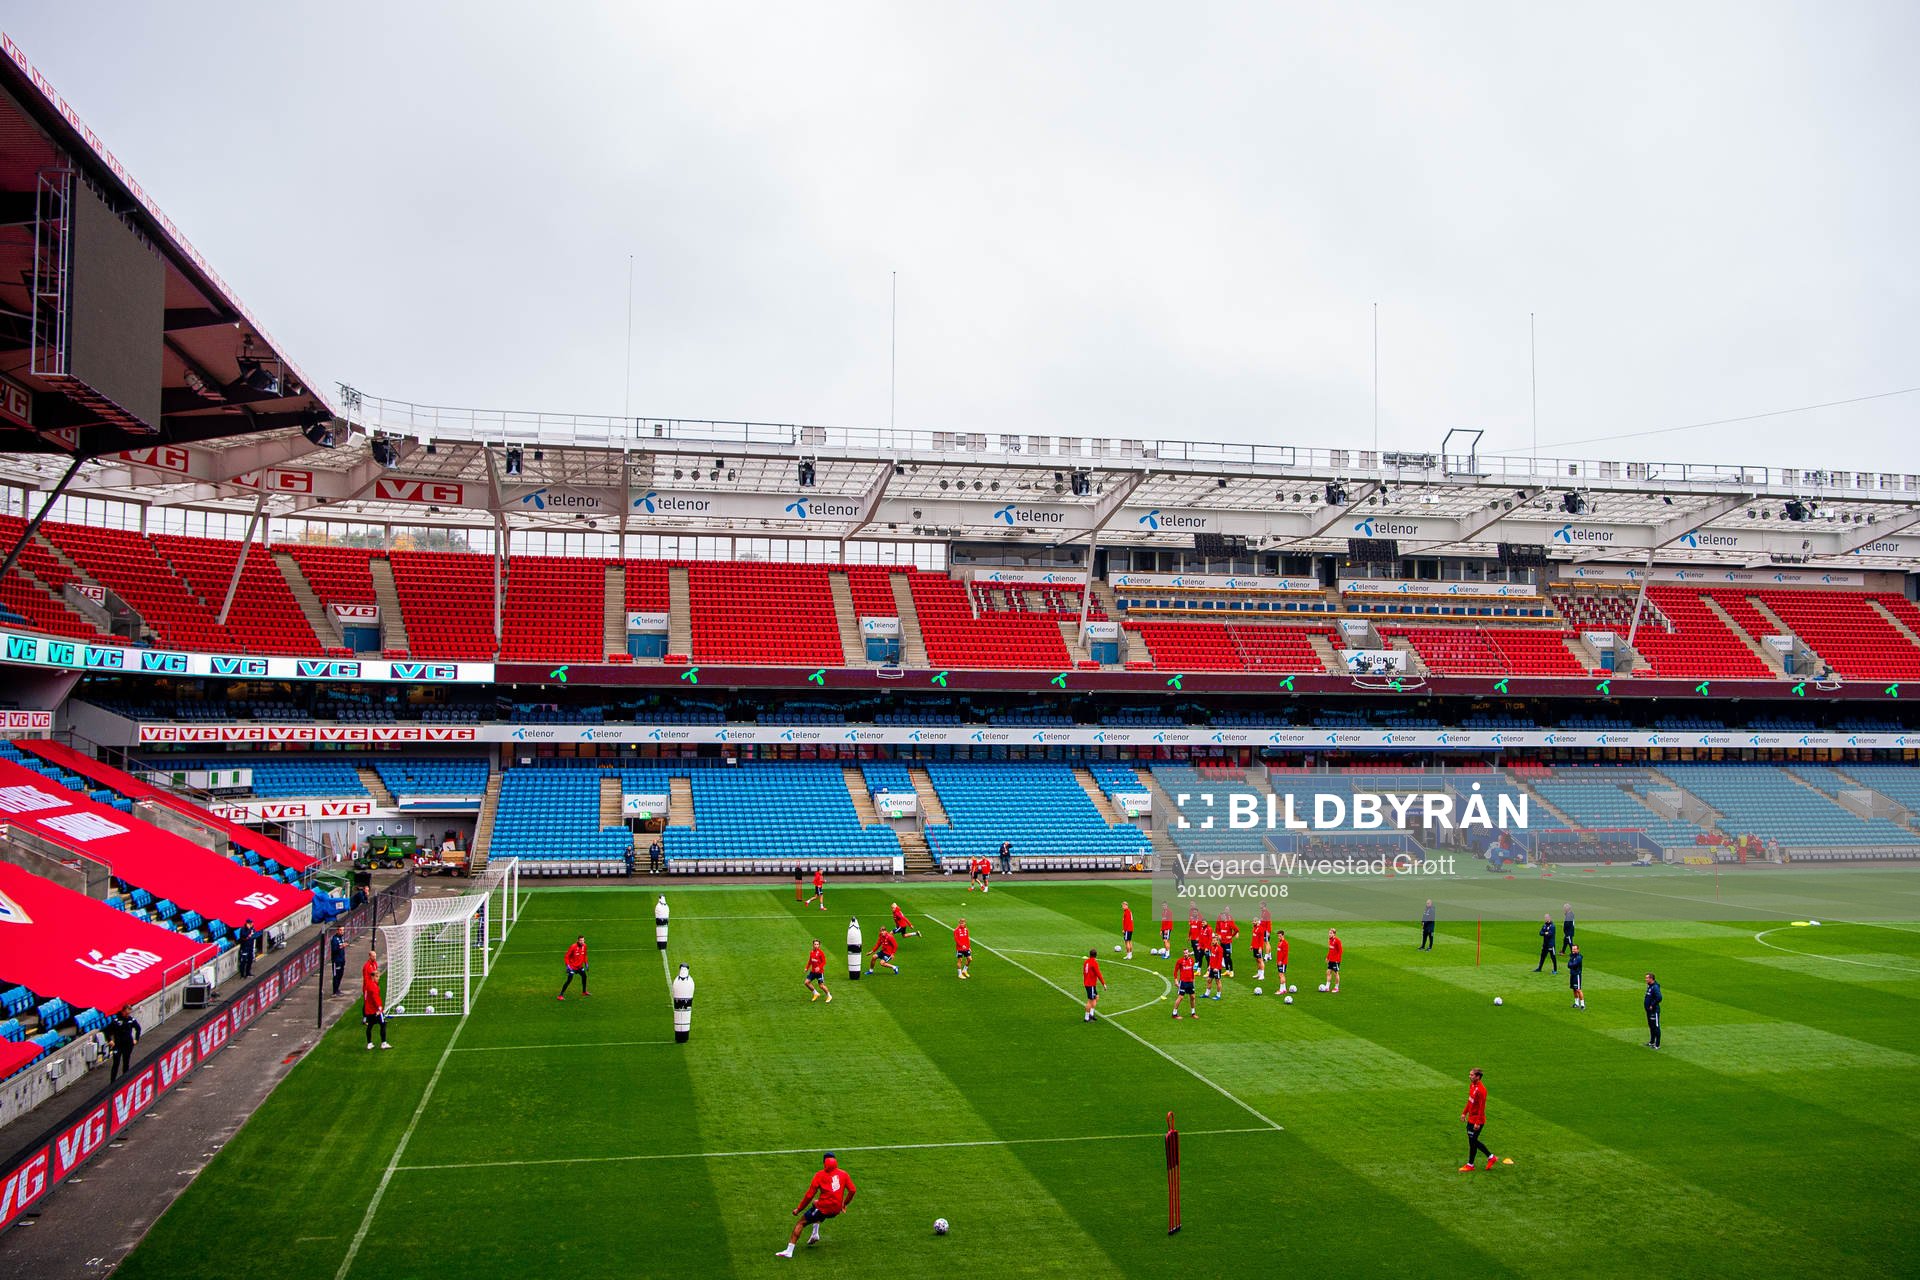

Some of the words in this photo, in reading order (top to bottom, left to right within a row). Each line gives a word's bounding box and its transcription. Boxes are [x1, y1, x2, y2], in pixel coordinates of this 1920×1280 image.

[127, 447, 188, 471] VG
[378, 479, 461, 503] VG
[547, 494, 601, 507] telenor
[658, 497, 710, 511] telenor
[809, 502, 859, 516] telenor
[1015, 509, 1064, 523] telenor
[1160, 514, 1207, 528] telenor
[1374, 522, 1418, 535] telenor
[1572, 529, 1614, 541] telenor
[1698, 534, 1738, 547] telenor
[998, 573, 1024, 581] telenor
[1126, 577, 1151, 585] telenor
[1180, 578, 1206, 586] telenor
[1234, 579, 1258, 587] telenor
[335, 606, 375, 617] VG
[641, 617, 664, 625] telenor
[874, 622, 896, 630] telenor
[8, 638, 36, 660] VG
[49, 644, 74, 663] VG
[85, 648, 123, 667] VG
[142, 653, 187, 672] VG
[1363, 654, 1398, 666] telenor
[211, 657, 267, 675] VG
[298, 661, 360, 678] VG
[391, 664, 456, 679] VG
[11, 714, 28, 726] VG
[32, 714, 49, 726] VG
[142, 728, 175, 740] VG
[180, 728, 218, 740] VG
[223, 728, 263, 740] VG
[269, 728, 315, 740] VG
[321, 728, 367, 740] VG
[374, 728, 419, 740] VG
[427, 728, 474, 740] VG
[525, 728, 554, 738] telenor
[593, 728, 622, 738] telenor
[661, 729, 689, 739] telenor
[727, 729, 755, 739] telenor
[792, 729, 820, 739] telenor
[857, 730, 884, 740] telenor
[920, 730, 947, 740] telenor
[983, 730, 1009, 740] telenor
[1044, 731, 1070, 741] telenor
[1105, 731, 1130, 741] telenor
[1164, 731, 1189, 741] telenor
[1222, 731, 1247, 741] telenor
[1280, 732, 1304, 742] telenor
[1336, 732, 1360, 742] telenor
[1392, 732, 1416, 742] telenor
[1447, 733, 1470, 743] telenor
[1501, 733, 1524, 743] telenor
[1554, 733, 1577, 743] telenor
[1606, 733, 1629, 743] telenor
[1657, 734, 1680, 744] telenor
[1707, 734, 1730, 744] telenor
[1757, 734, 1780, 744] telenor
[1806, 734, 1828, 744] telenor
[1856, 735, 1877, 745] telenor
[638, 799, 663, 807] telenor
[889, 798, 913, 807] telenor
[1127, 798, 1149, 807] telenor
[215, 808, 247, 819] VG
[263, 805, 304, 817] VG
[322, 803, 369, 816] VG
[235, 892, 279, 910] VG
[259, 975, 280, 1008] VG
[231, 994, 256, 1029] VG
[199, 1015, 227, 1055] VG
[160, 1039, 192, 1087] VG
[114, 1070, 153, 1125] VG
[58, 1108, 105, 1172] VG
